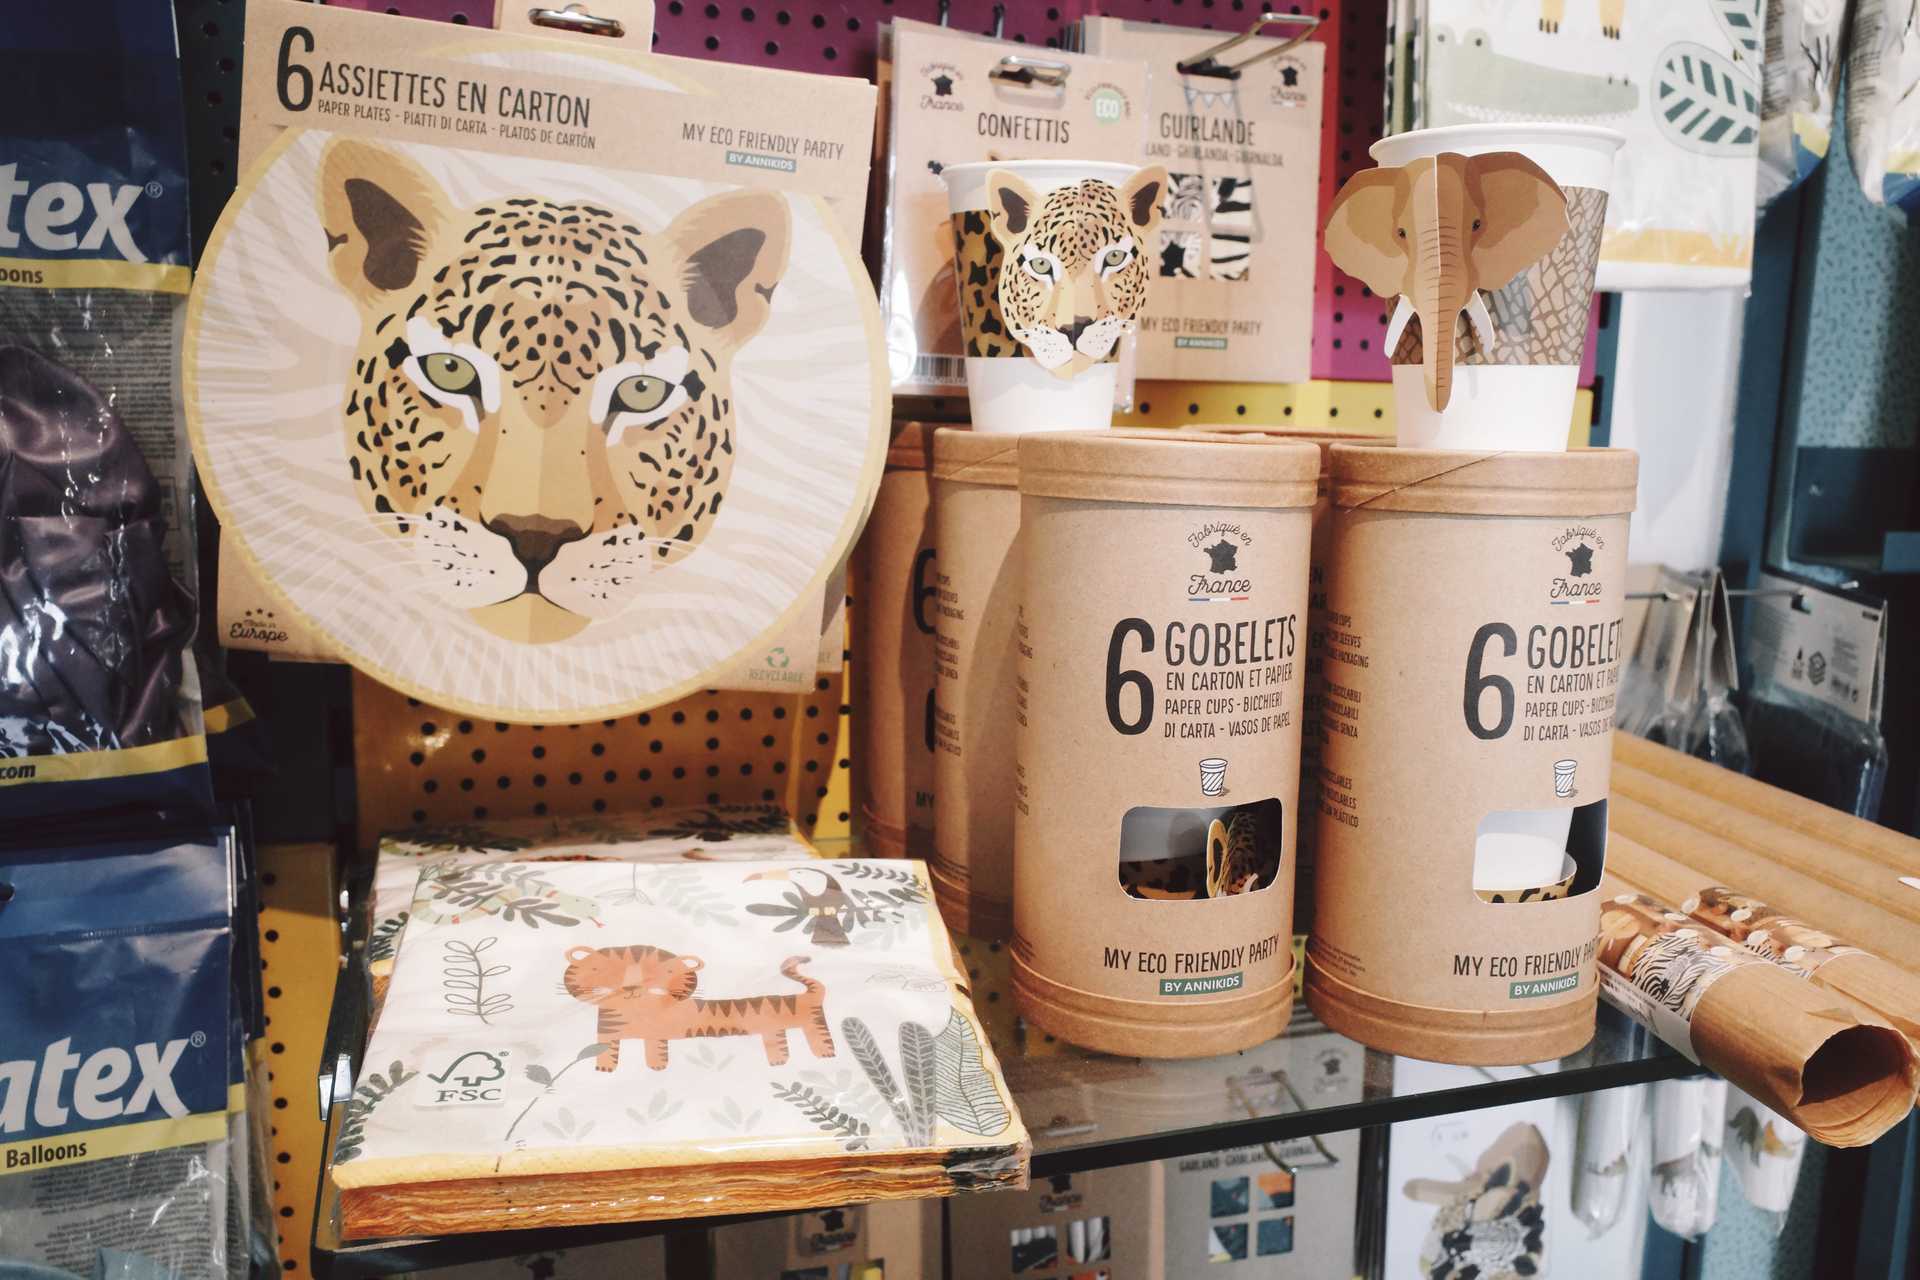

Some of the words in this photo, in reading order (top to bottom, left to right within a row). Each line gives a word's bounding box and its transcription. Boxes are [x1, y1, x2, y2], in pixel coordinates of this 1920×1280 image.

[277, 26, 314, 111] 6
[319, 61, 447, 108] ASSIETTES
[457, 81, 486, 114] EN
[498, 86, 590, 128] CARTON
[318, 99, 350, 116] PAPER
[354, 104, 391, 122] PLATES
[403, 111, 437, 128] PIATTI
[441, 114, 452, 130] DI
[455, 118, 487, 136] CARTA
[499, 125, 537, 142] PLATOS
[540, 130, 553, 144] DE
[978, 112, 1070, 144] CONFETTIS
[1160, 112, 1256, 145] GUIRLANDE
[682, 122, 706, 142] MY
[710, 126, 733, 146] ECO
[738, 130, 799, 154] FRIENDLY
[803, 139, 844, 161] PARTY
[729, 153, 743, 164] BY
[744, 154, 794, 171] ANNIKIDS
[1141, 316, 1157, 332] MY
[1162, 317, 1179, 333] ECO
[1183, 317, 1229, 335] FRIENDLY
[1232, 320, 1262, 336] PARTY
[1187, 574, 1251, 595] France
[1550, 577, 1602, 598] France
[230, 622, 289, 643] Europe
[1105, 617, 1155, 735] 6
[1165, 614, 1297, 667] GOBELETS
[1166, 672, 1185, 691] EN
[1191, 671, 1244, 691] CARTON
[1249, 669, 1261, 688] ET
[1265, 663, 1293, 685] PAPIER
[1463, 622, 1517, 740] 6
[1528, 616, 1623, 669] GOBELET
[1527, 675, 1544, 694] EN
[1550, 673, 1593, 694] CARTON
[1596, 670, 1606, 689] ET
[1165, 698, 1201, 715] PAPER
[1206, 698, 1234, 715] CUPS
[1243, 691, 1283, 712] BICCHIERI
[1525, 701, 1557, 718] PAPER
[1562, 699, 1585, 717] CUPS
[1164, 722, 1175, 739] DI
[1181, 721, 1216, 739] CARTA
[1229, 719, 1258, 737] VASOS
[1261, 715, 1272, 733] DE
[1273, 711, 1291, 730] PAPEL
[1524, 725, 1534, 741] DI
[1539, 724, 1569, 741] CARTA
[1579, 719, 1601, 738] VASOS
[1104, 946, 1131, 971] MY
[1138, 952, 1167, 974] ECO
[1175, 946, 1245, 974] FRIENDLY
[1249, 933, 1280, 964] PARTY
[1453, 954, 1483, 977] MY
[1489, 956, 1518, 977] ECO
[1524, 944, 1582, 976] FRIENDLY
[1164, 981, 1184, 992] BY
[1184, 975, 1240, 992] ANNIKIDS
[1513, 984, 1530, 996] BY
[1531, 975, 1577, 995] ANNIKIDS
[435, 1088, 502, 1102] FSC
[6, 1142, 87, 1169] Balloons
